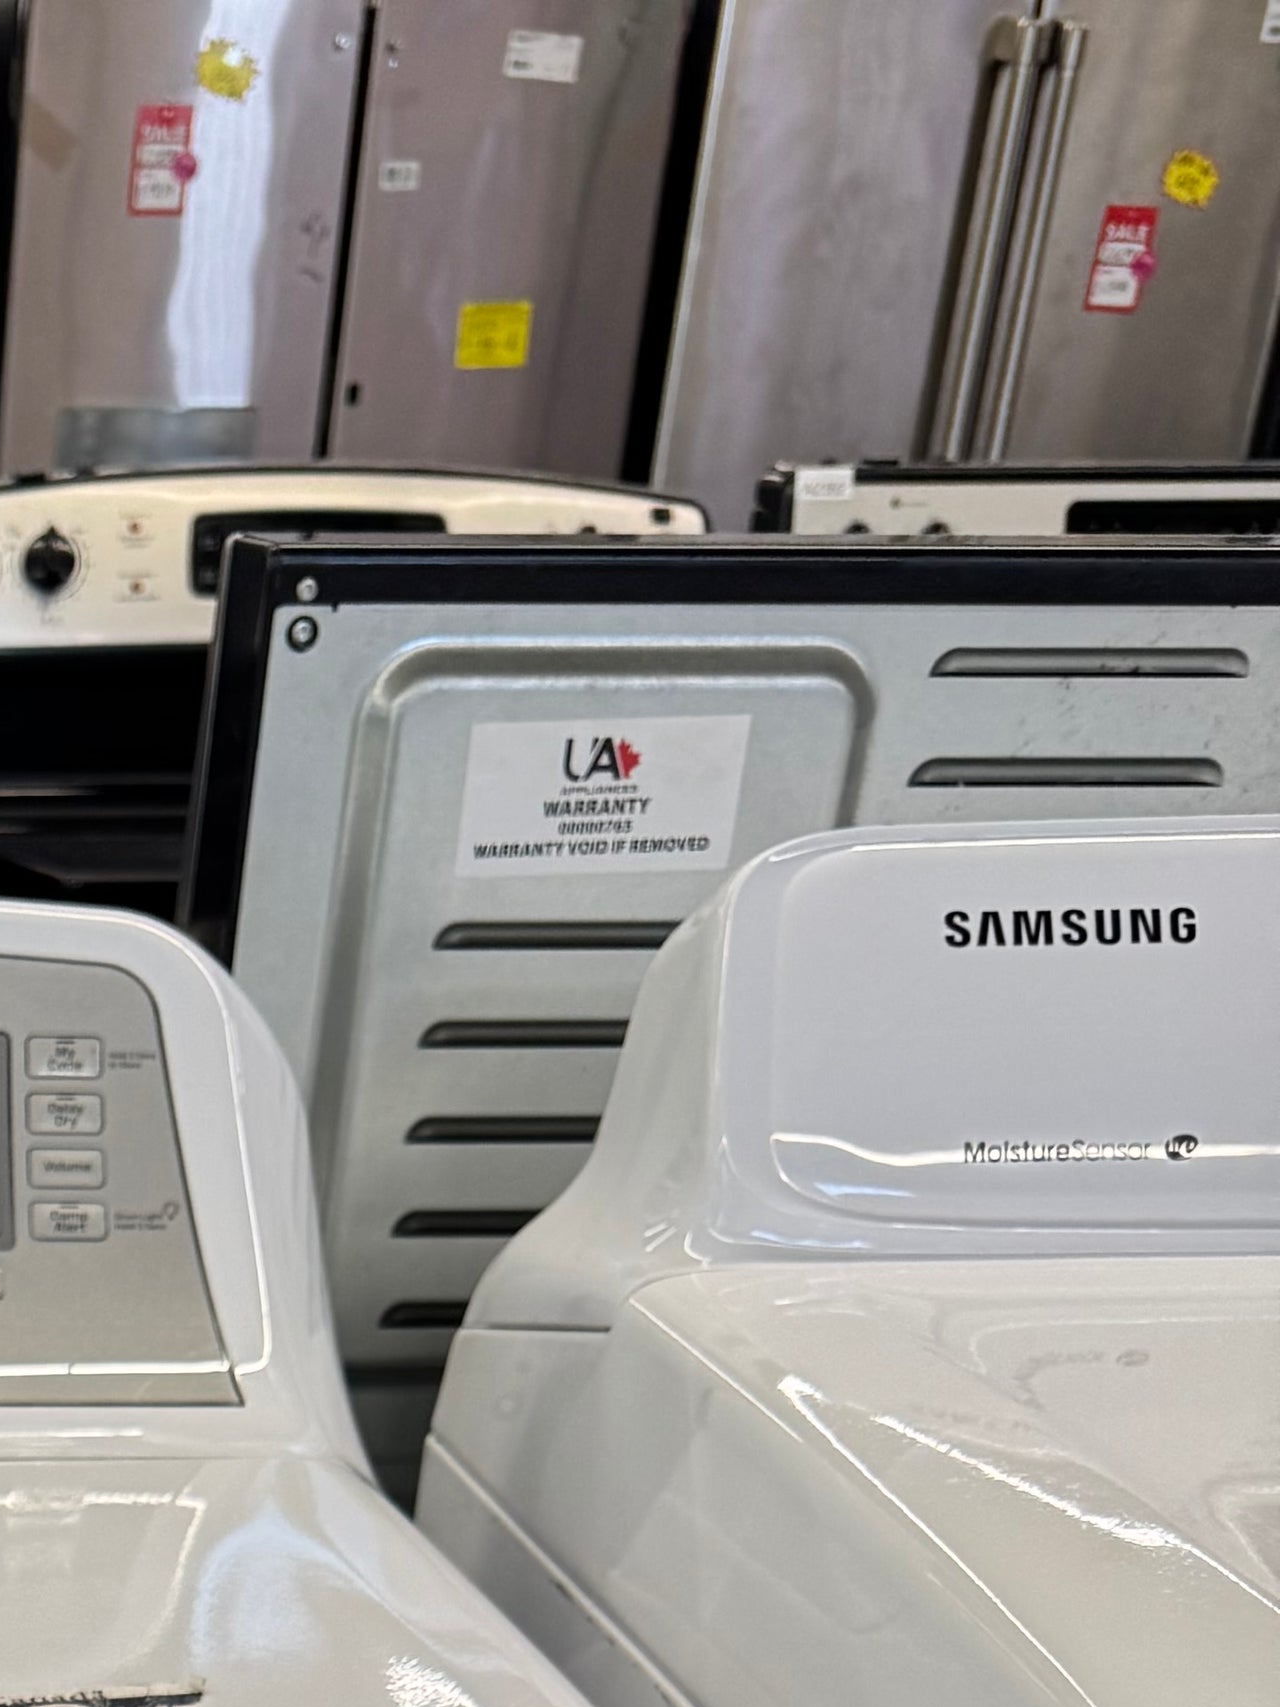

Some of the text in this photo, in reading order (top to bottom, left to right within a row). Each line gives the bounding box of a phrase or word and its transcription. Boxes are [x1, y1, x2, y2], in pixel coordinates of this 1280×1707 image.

[543, 798, 652, 818] WARRANTY
[473, 837, 711, 859] WARRANTY VOID IF REMOVED
[944, 906, 1199, 947] SAMSUNG
[963, 1138, 1152, 1164] MoistureSensor
